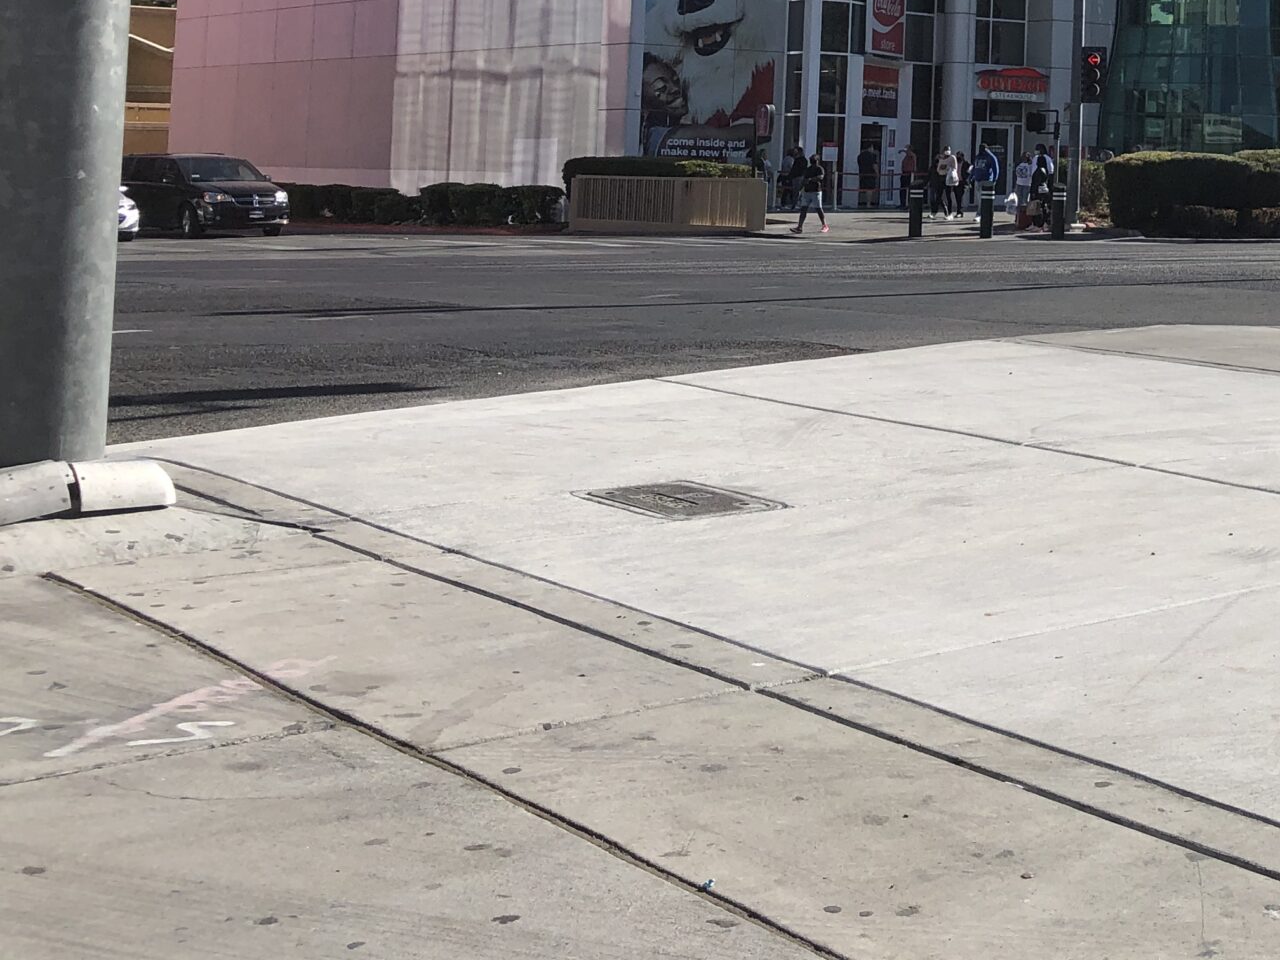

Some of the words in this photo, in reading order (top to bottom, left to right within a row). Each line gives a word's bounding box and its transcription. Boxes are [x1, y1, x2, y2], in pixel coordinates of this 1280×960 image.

[880, 39, 896, 52] store
[668, 138, 694, 146] come
[696, 137, 725, 147] inside
[727, 139, 746, 148] and
[661, 147, 688, 156] make
[699, 149, 720, 157] new
[722, 148, 748, 158] frien
